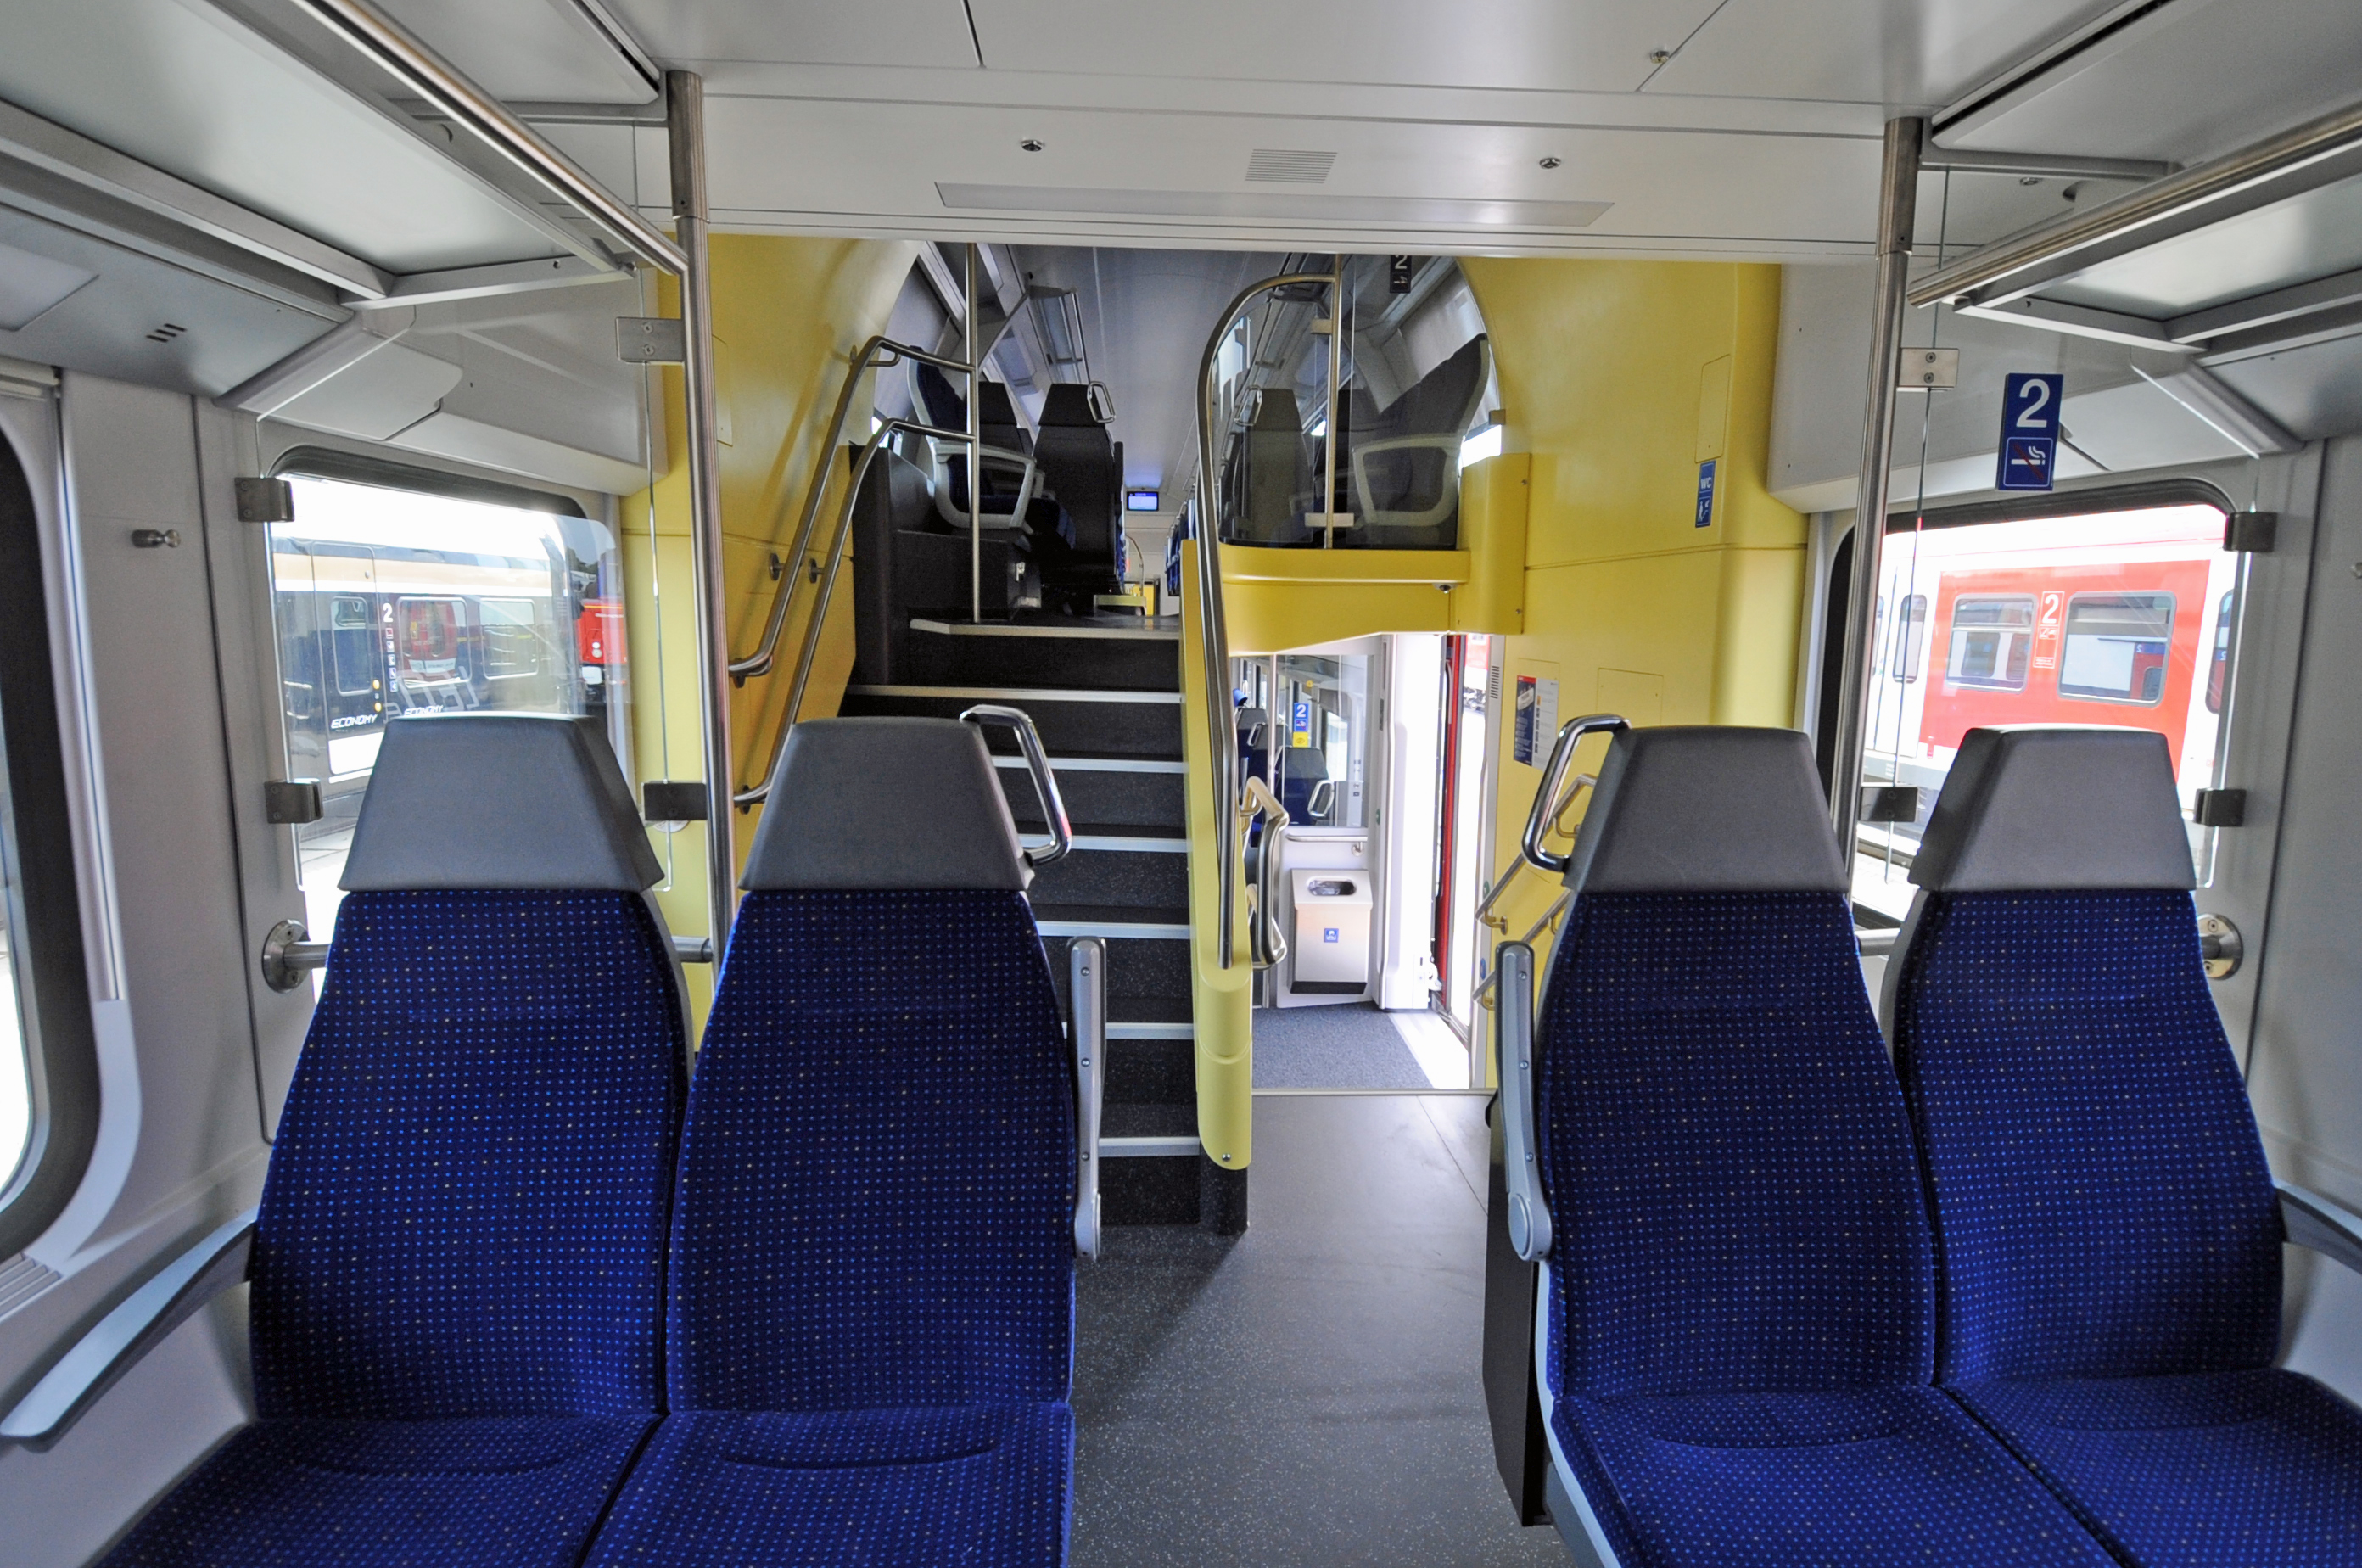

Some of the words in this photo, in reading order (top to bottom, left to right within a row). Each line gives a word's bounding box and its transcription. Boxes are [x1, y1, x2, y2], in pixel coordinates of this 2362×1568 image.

[1395, 255, 1408, 269] 2
[2016, 378, 2050, 428] 2
[1700, 477, 1712, 490] WC
[383, 602, 394, 623] 2
[2042, 594, 2059, 624] 2
[1296, 704, 1307, 718] 2
[331, 714, 378, 730] ECONOMY
